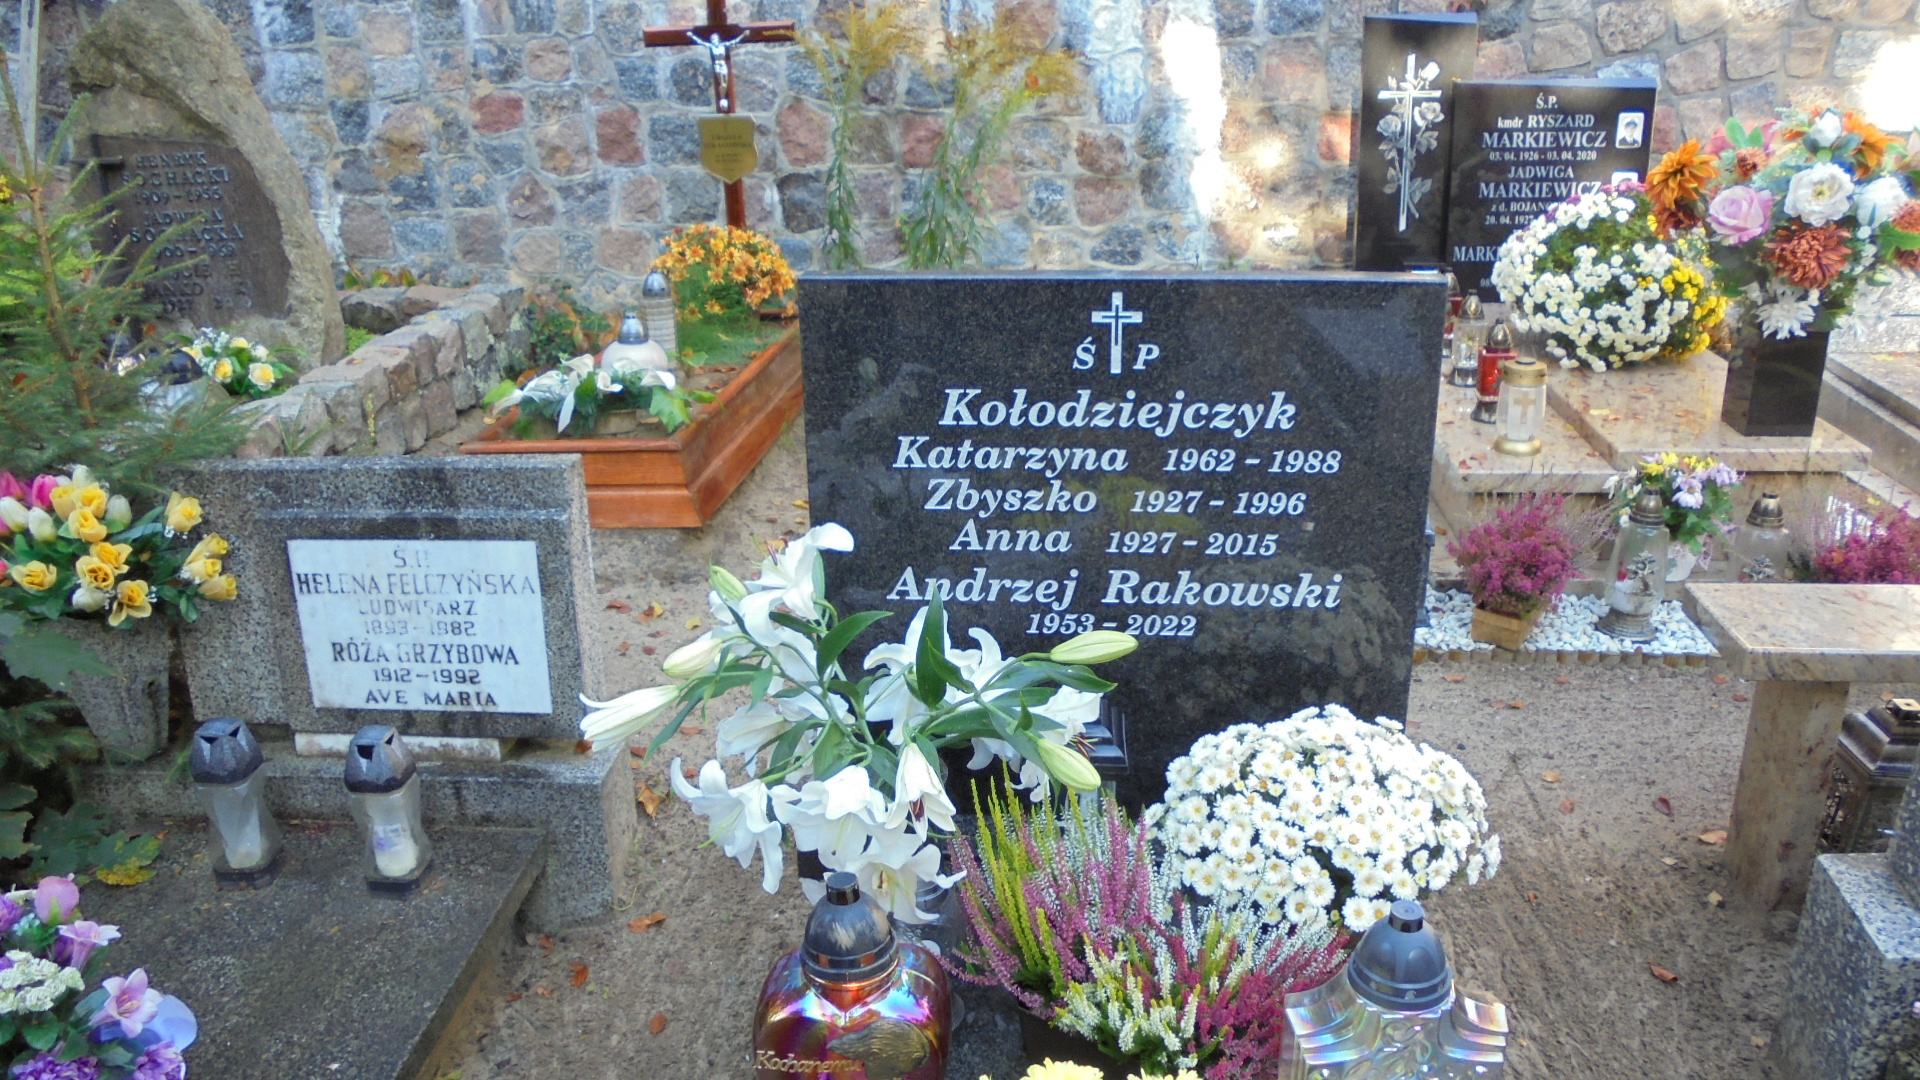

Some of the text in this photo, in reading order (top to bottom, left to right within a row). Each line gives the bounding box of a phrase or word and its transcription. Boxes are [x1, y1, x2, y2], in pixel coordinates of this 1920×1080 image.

[1497, 114, 1595, 128] kmdr RYSZARD
[1482, 131, 1607, 148] MARKIEWICZ
[135, 152, 208, 168] HENRYK
[1519, 151, 1539, 161] 1926
[1576, 150, 1597, 160] 2020
[122, 165, 229, 187] SOCHACKI
[1508, 165, 1575, 179] JADWIGA
[1478, 181, 1602, 198] MARKIEWICZ
[1491, 203, 1496, 212] z
[1073, 336, 1160, 371] Ś P
[938, 387, 1296, 438] Kołodziejczyk
[892, 435, 1129, 478] Katarzyna
[1163, 448, 1236, 473] 1962
[1267, 449, 1342, 474] 1988
[924, 478, 1098, 517] Zbyszko
[1130, 489, 1202, 514] 1927
[1232, 491, 1307, 515] 1996
[949, 517, 1072, 553] Anna
[1105, 530, 1177, 554] 1927
[1205, 531, 1279, 556] 2015
[296, 570, 536, 595] HELENA FELCZYŃSKA
[886, 565, 1343, 610] Andrzej Rakowski
[1025, 612, 1095, 636] 1953
[1125, 613, 1197, 637] 2022
[331, 637, 520, 666] RÓŻA GRZYBOWA
[365, 690, 497, 706] AVE MARIA
